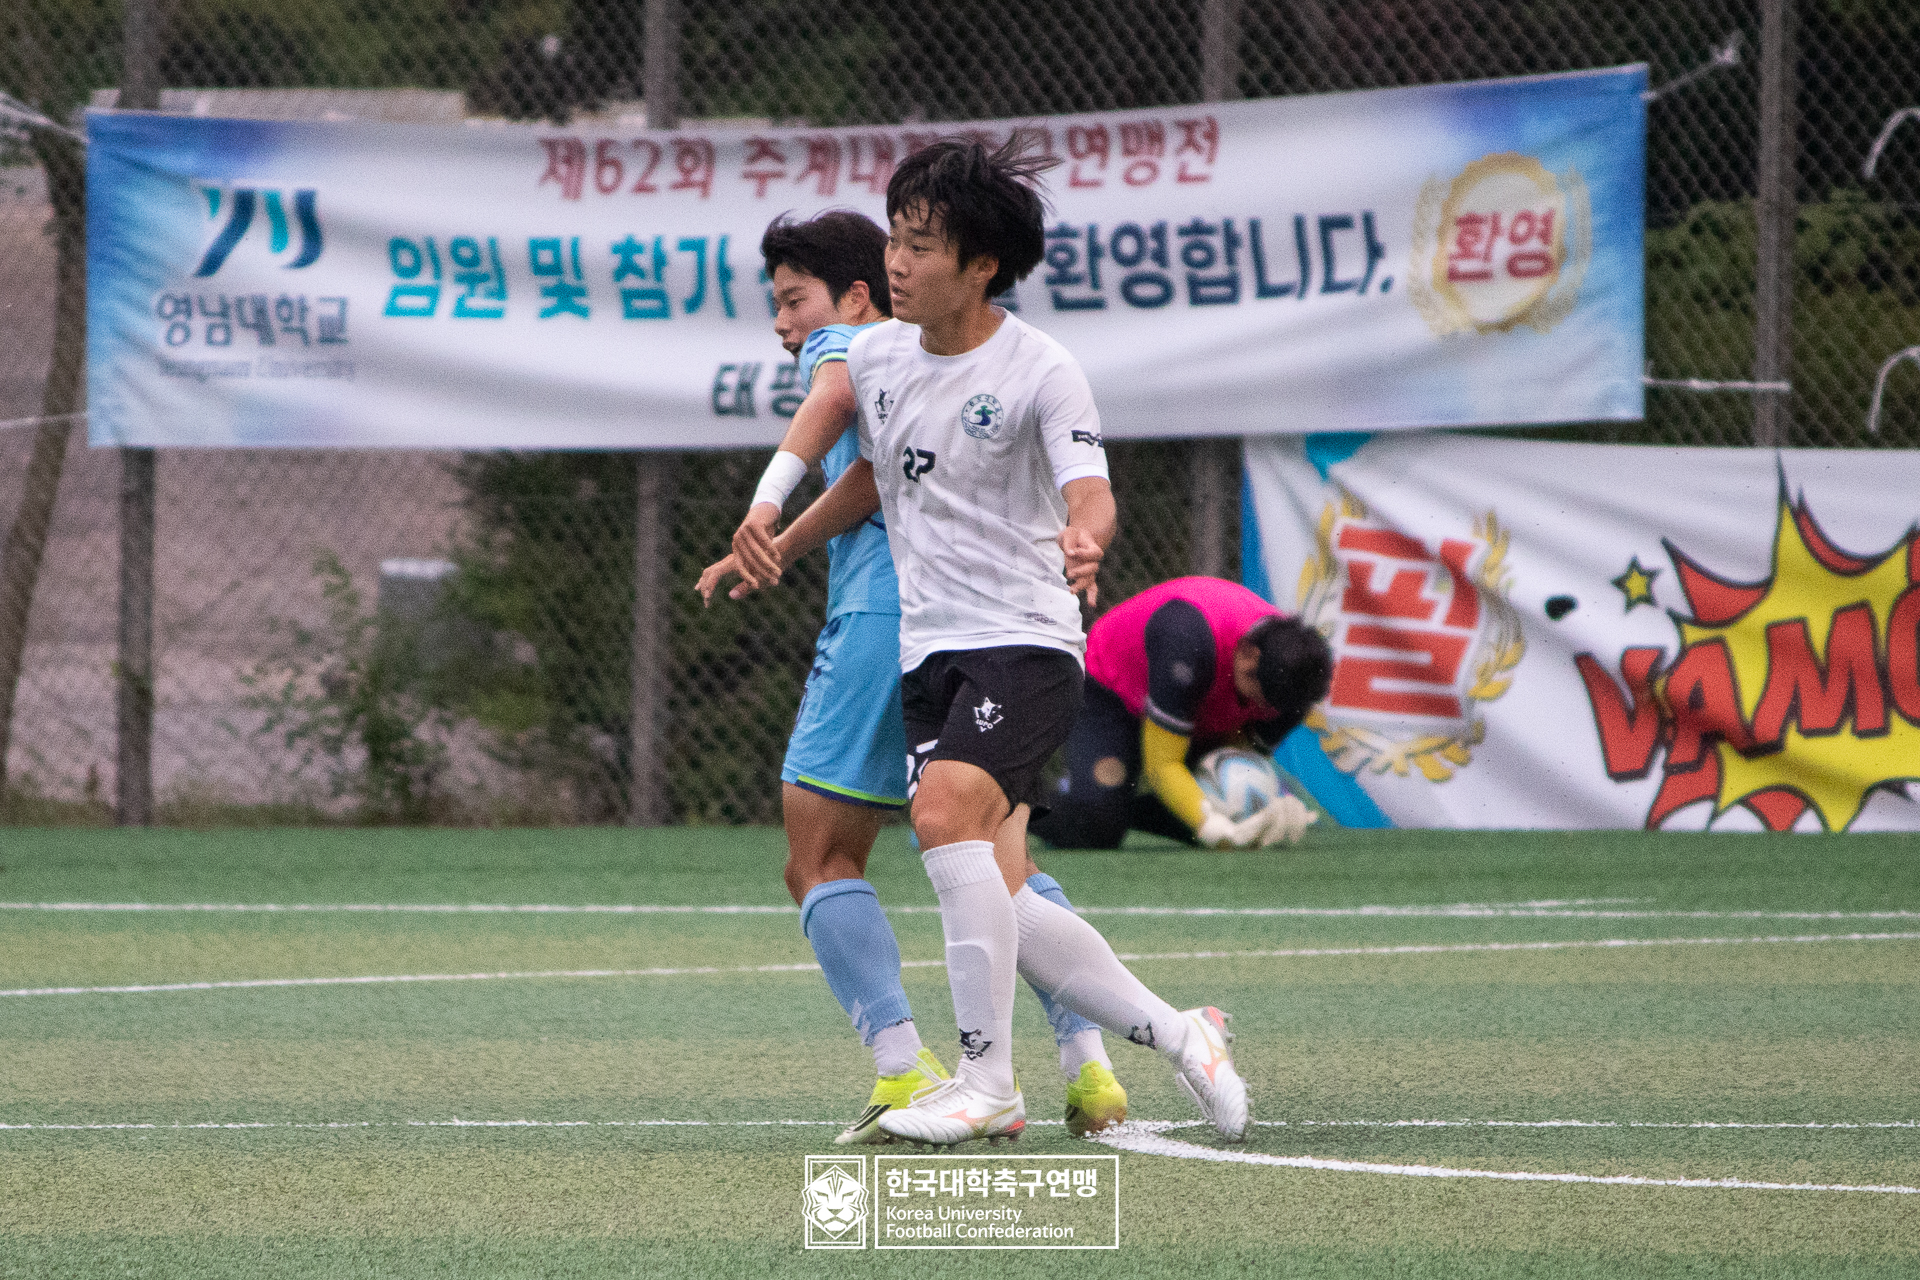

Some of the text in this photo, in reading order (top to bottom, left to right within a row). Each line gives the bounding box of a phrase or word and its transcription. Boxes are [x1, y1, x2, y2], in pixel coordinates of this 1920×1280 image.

[538, 136, 717, 201] 제62회
[382, 235, 507, 320] 임원
[527, 235, 590, 320] 및
[610, 232, 737, 321] 참가
[1044, 210, 1396, 312] 환영합니다.
[1447, 208, 1556, 284] 환영
[157, 292, 350, 347] 영남대학교
[902, 445, 937, 474] 27
